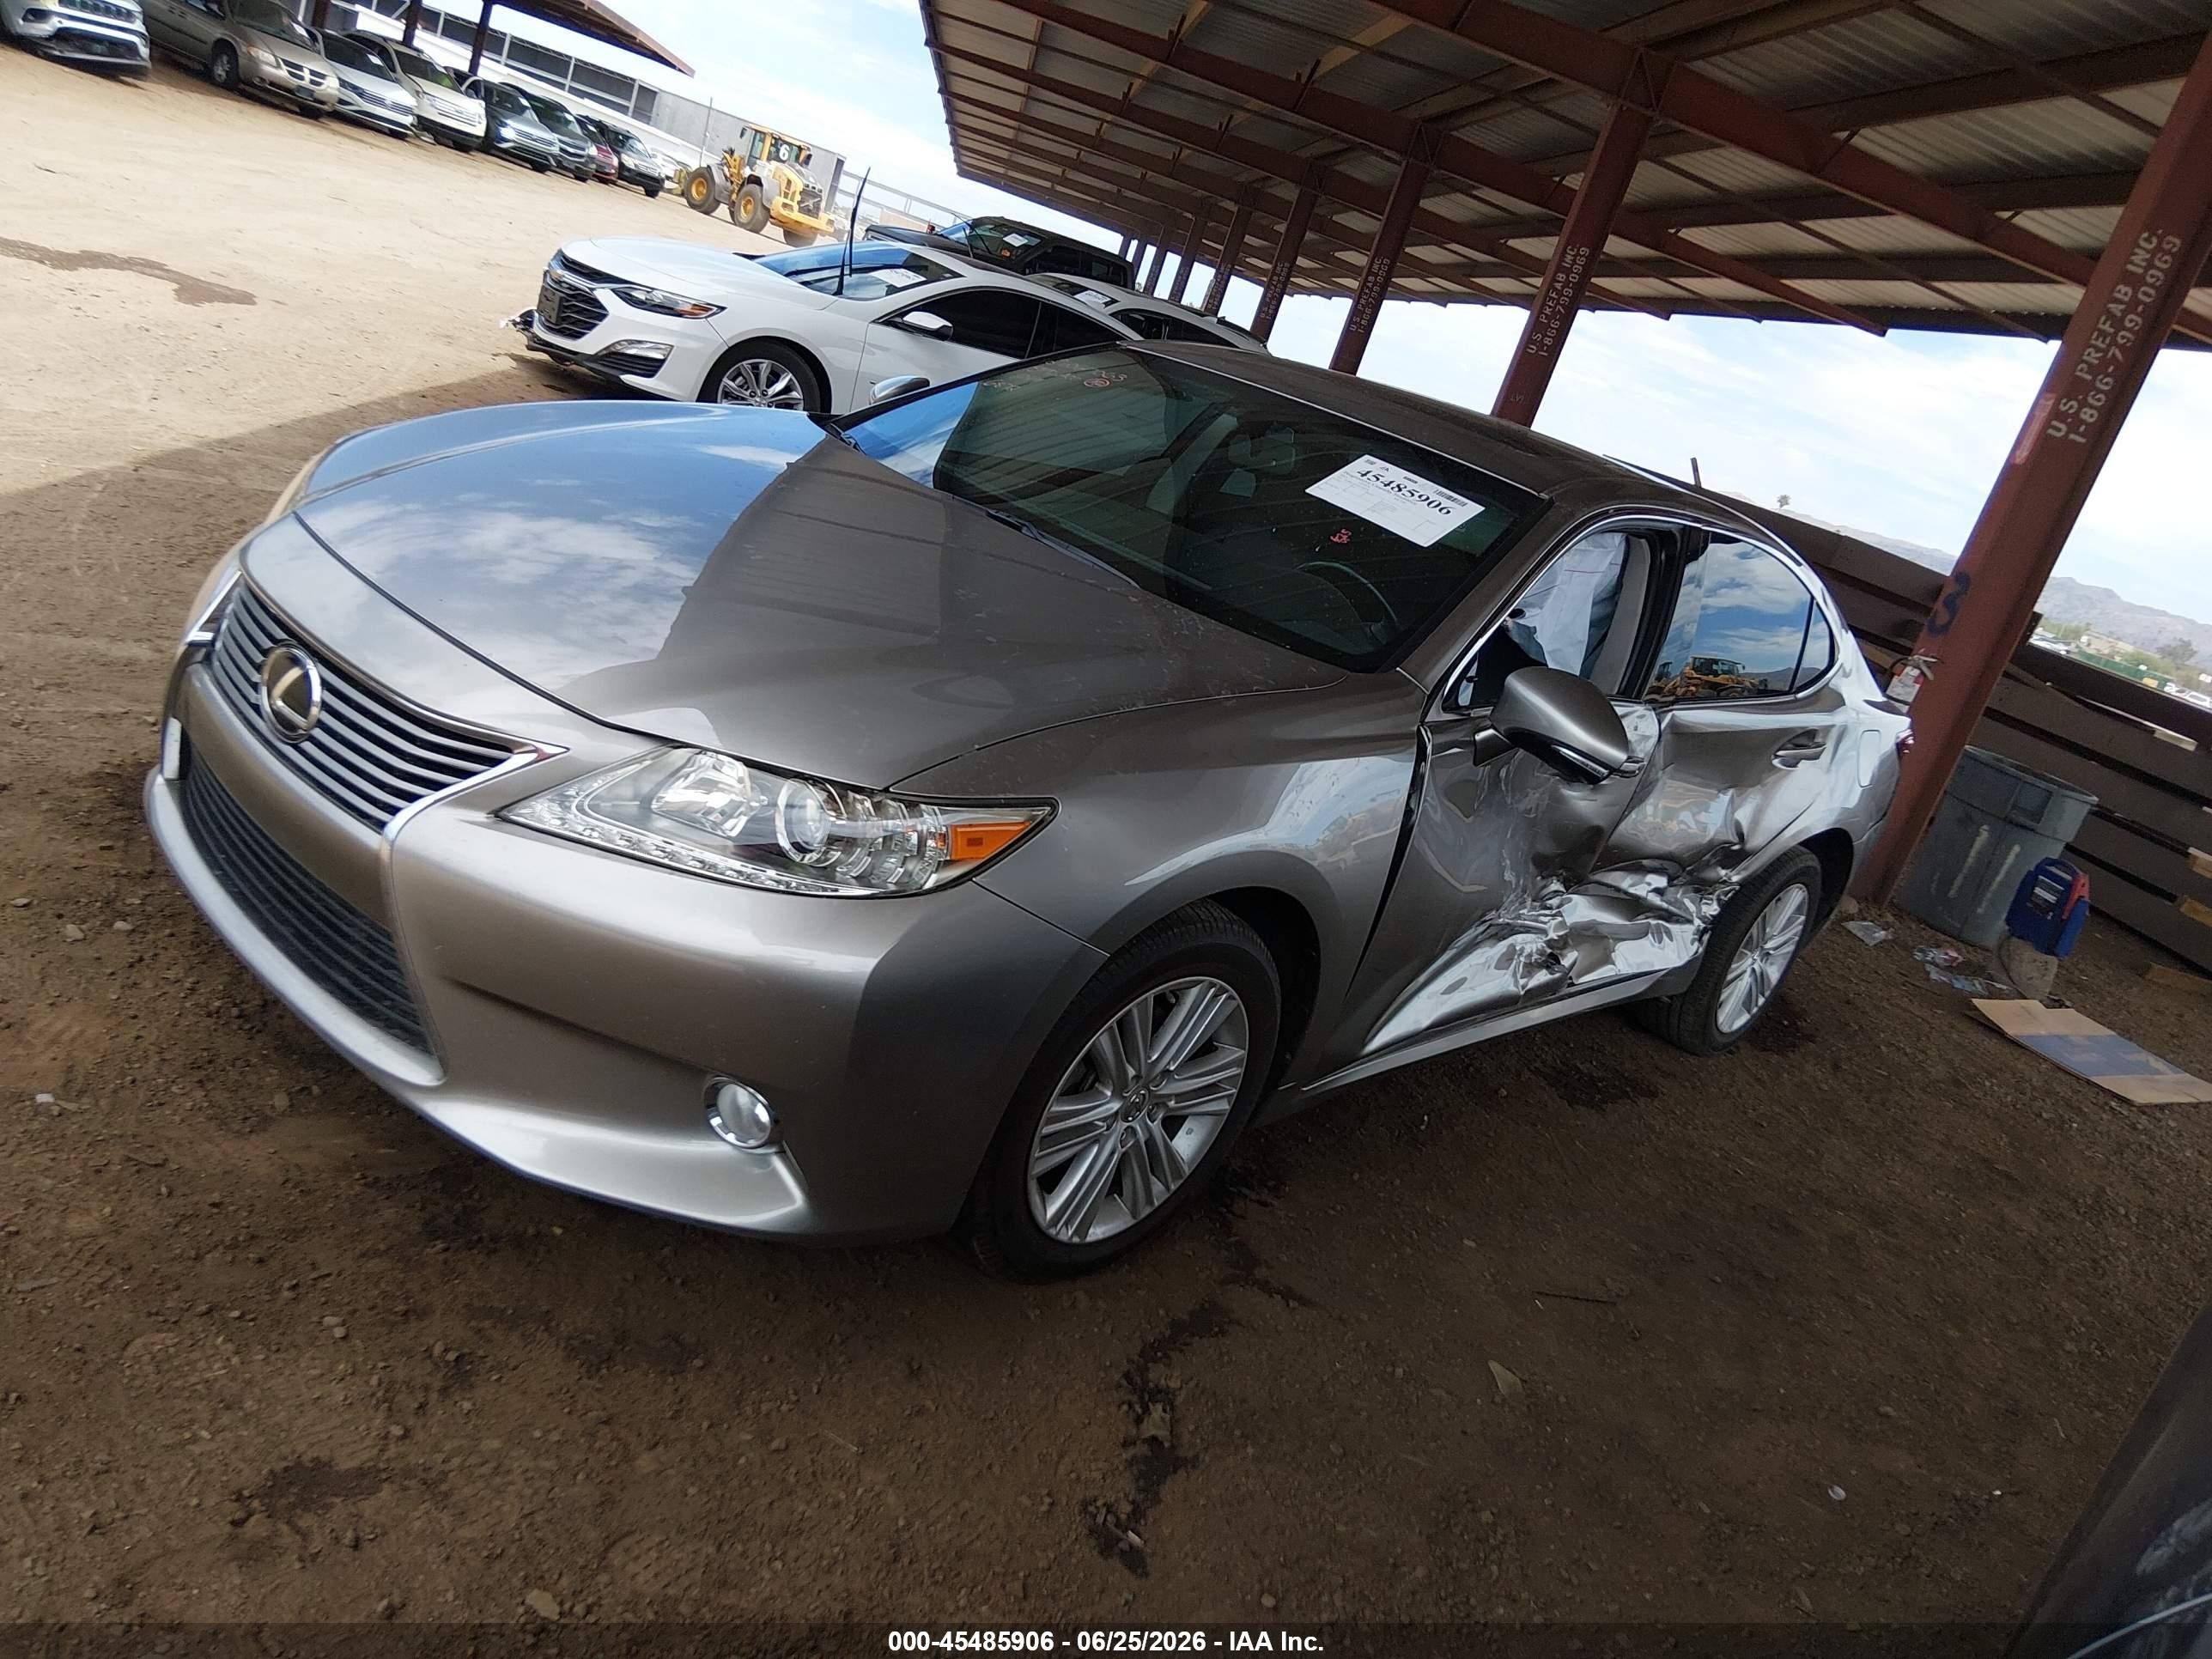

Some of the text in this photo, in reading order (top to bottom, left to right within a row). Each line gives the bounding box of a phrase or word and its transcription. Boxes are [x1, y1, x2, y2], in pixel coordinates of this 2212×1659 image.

[779, 143, 790, 161] 6
[1537, 246, 1590, 357] 1-866-799-0969
[1538, 272, 1567, 324] PREFAB
[2046, 228, 2164, 439] U.S. PREFAB INC.
[2068, 234, 2183, 444] 1-866-799-0969
[1357, 469, 1457, 516] 45485906
